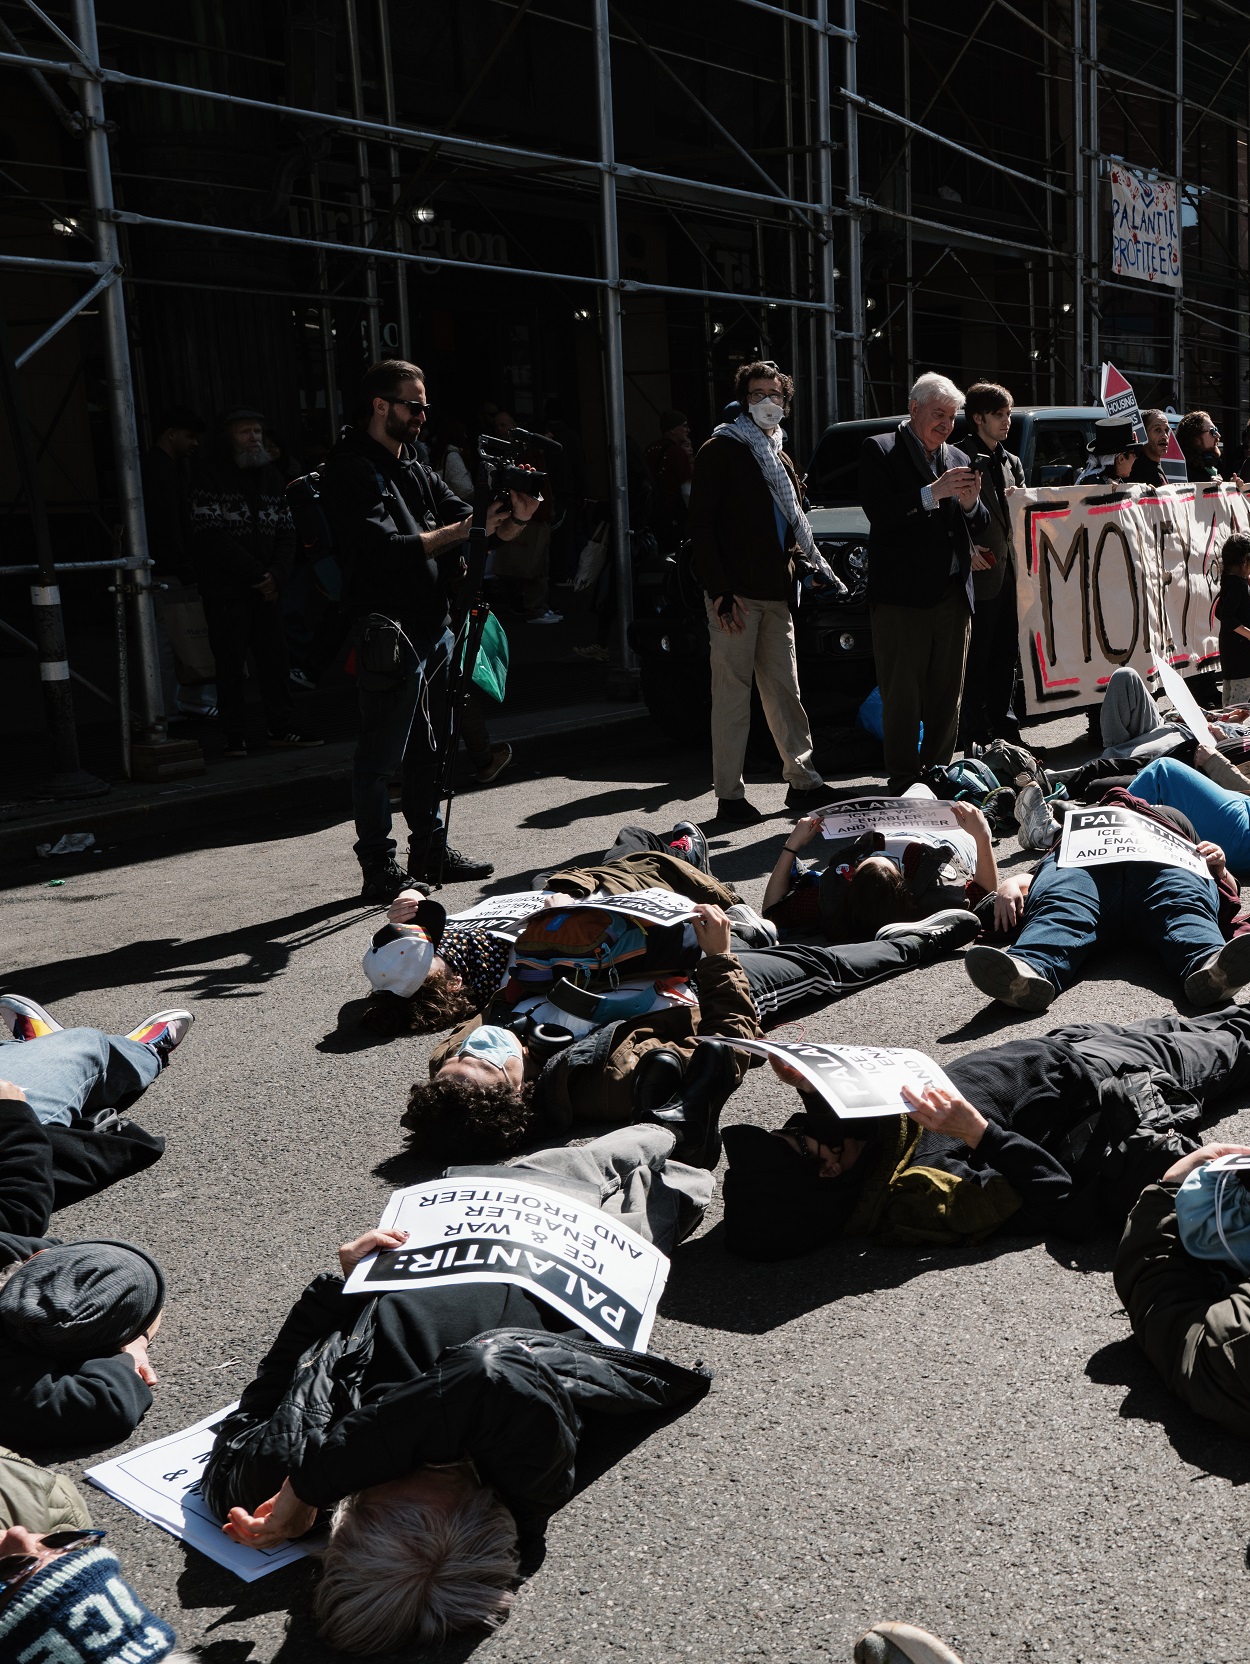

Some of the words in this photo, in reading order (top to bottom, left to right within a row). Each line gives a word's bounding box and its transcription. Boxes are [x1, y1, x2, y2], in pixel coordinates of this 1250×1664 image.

[1111, 199, 1178, 240] PALANTIR
[1113, 236, 1179, 277] PROFITEER
[1107, 396, 1135, 415] HOUSING
[837, 825, 866, 834] AND
[1097, 829, 1121, 837] ICE
[1076, 849, 1107, 858] AND
[608, 900, 673, 918] MONEY
[849, 1055, 877, 1074] ICE
[419, 1190, 578, 1223] PROFITEER
[595, 1224, 643, 1260] AND
[465, 1205, 598, 1250] ENABLER
[444, 1222, 511, 1237] WAR
[532, 1229, 547, 1244] &
[563, 1242, 605, 1275] ICE
[393, 1244, 626, 1332] PALANTIR:
[162, 1468, 189, 1482] &
